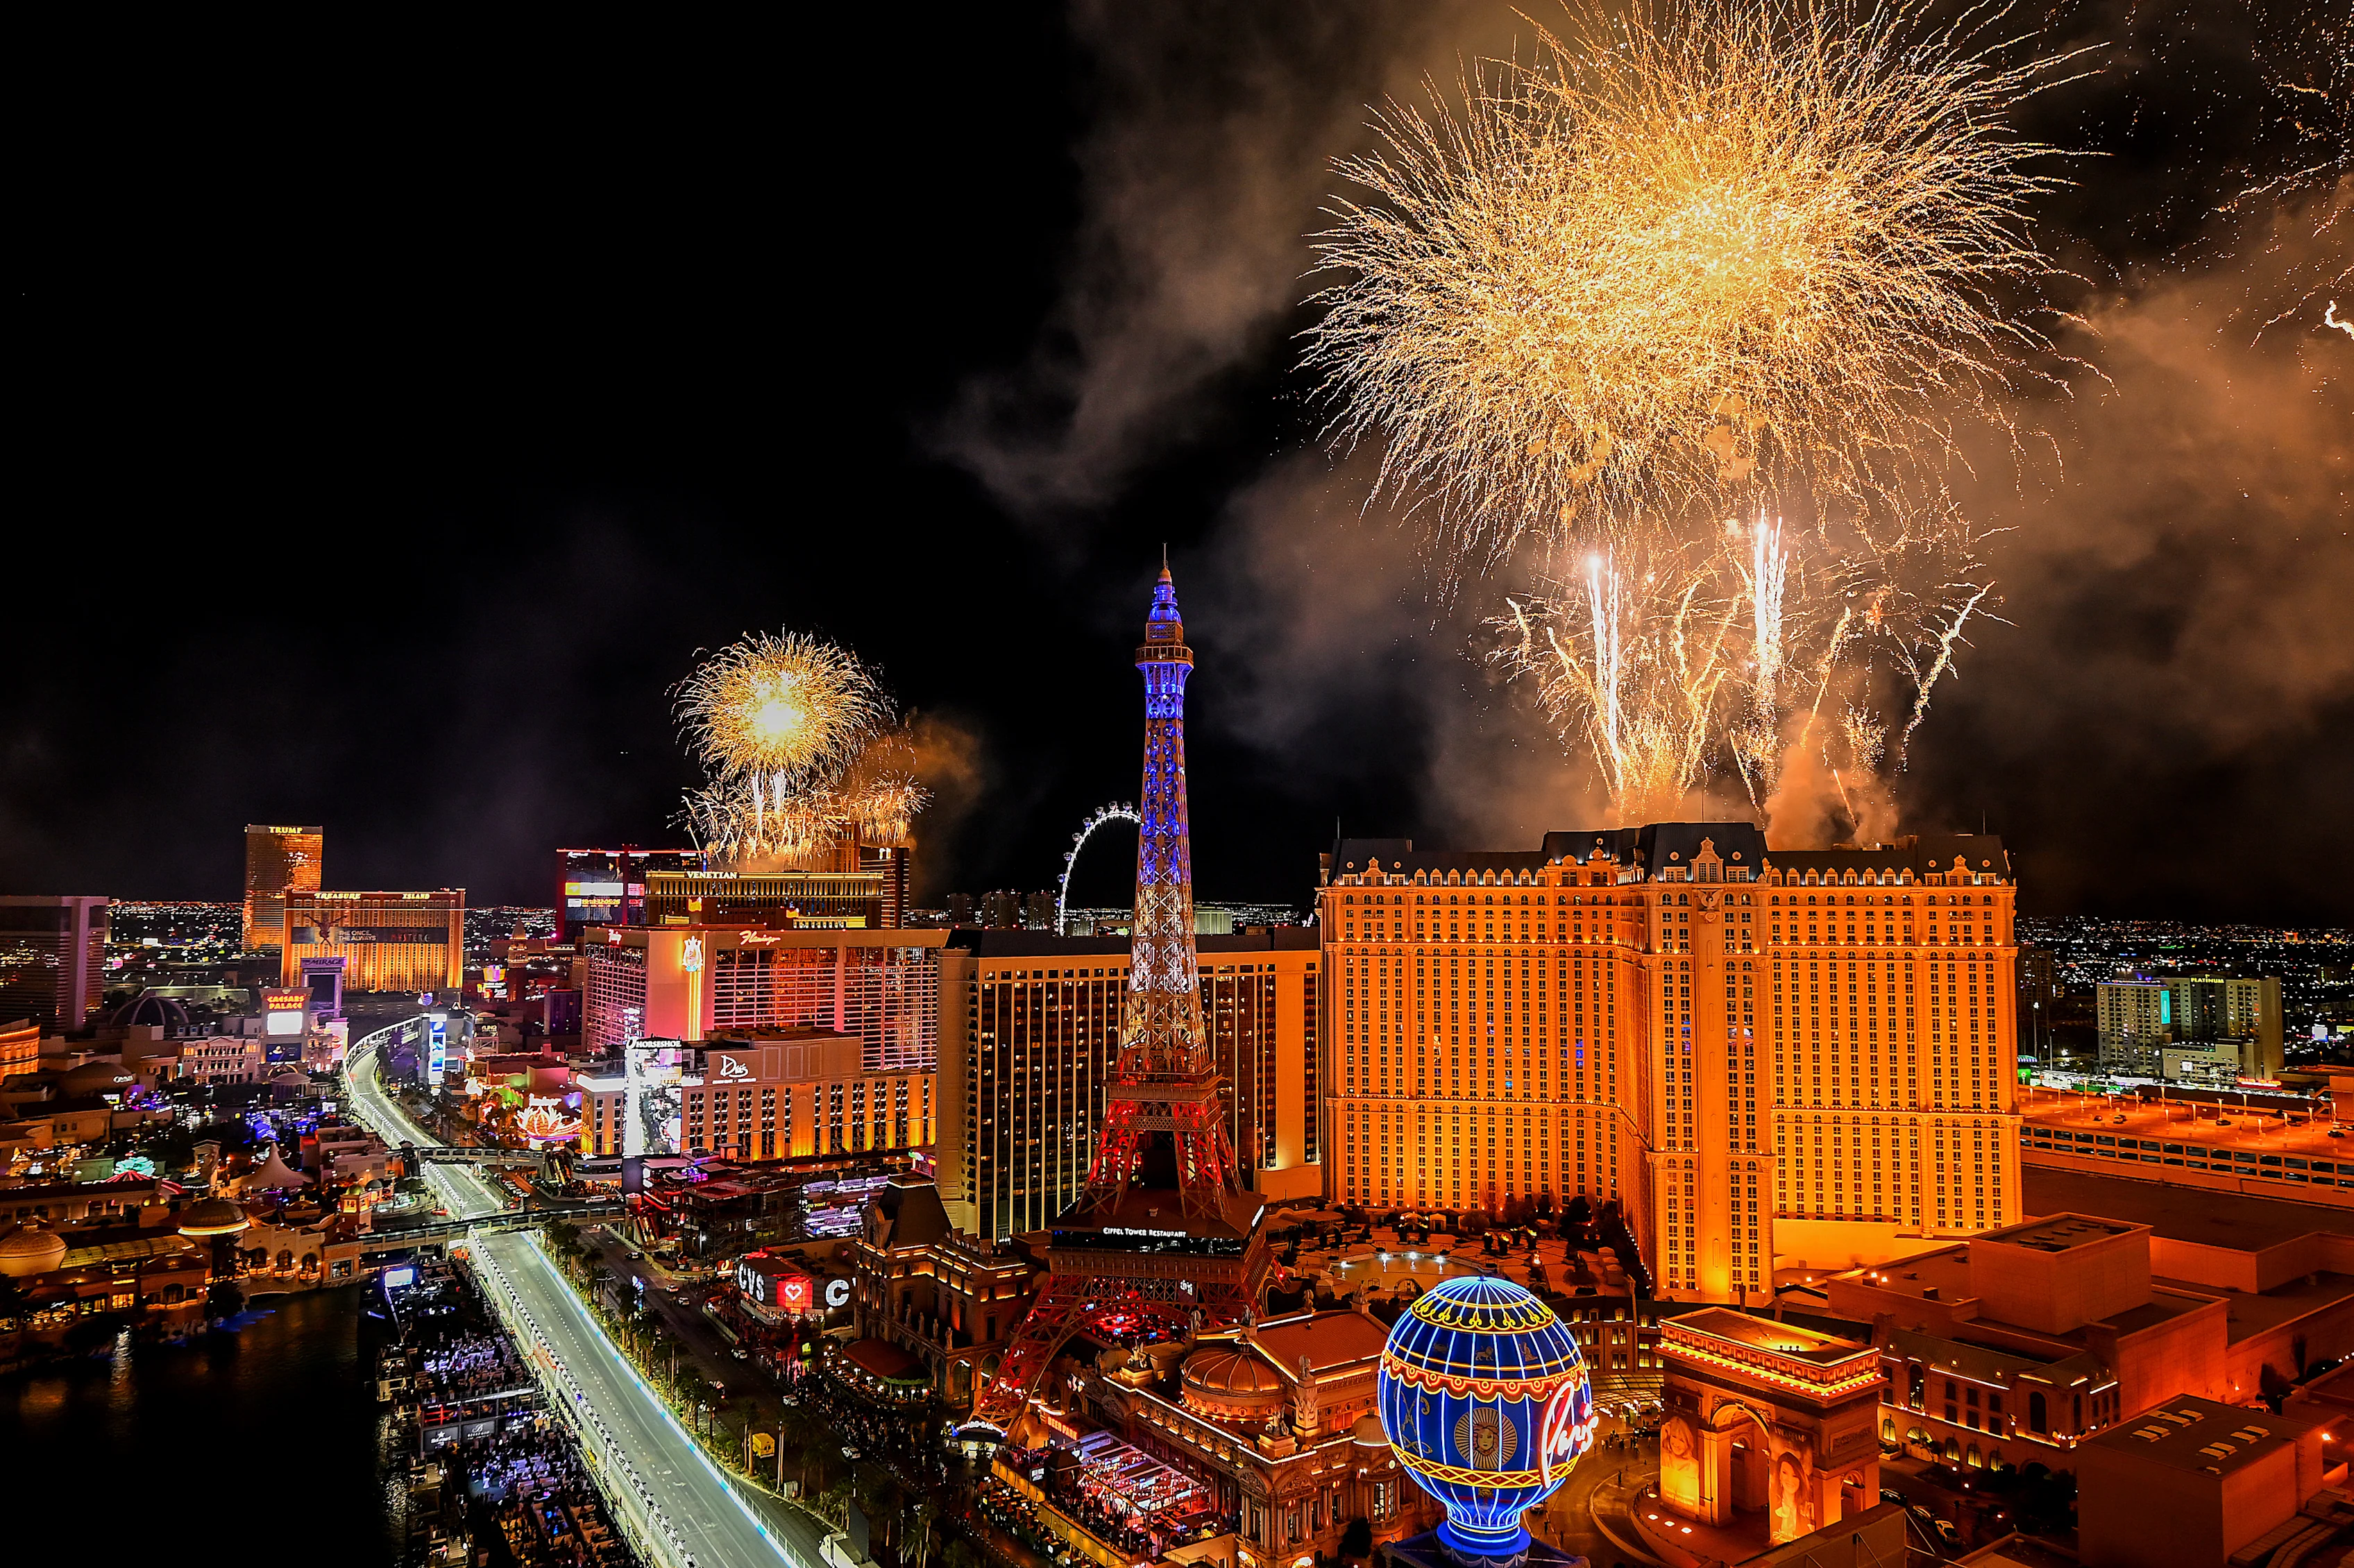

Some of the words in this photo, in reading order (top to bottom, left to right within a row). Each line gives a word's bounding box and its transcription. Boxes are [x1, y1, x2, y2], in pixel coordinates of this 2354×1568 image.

[1149, 1229, 1187, 1238] RESTAURANT
[738, 1263, 765, 1302] CVS
[1047, 1416, 1062, 1432] BEER
[1062, 1424, 1078, 1441] PARK
[1541, 1381, 1599, 1489] Paris
